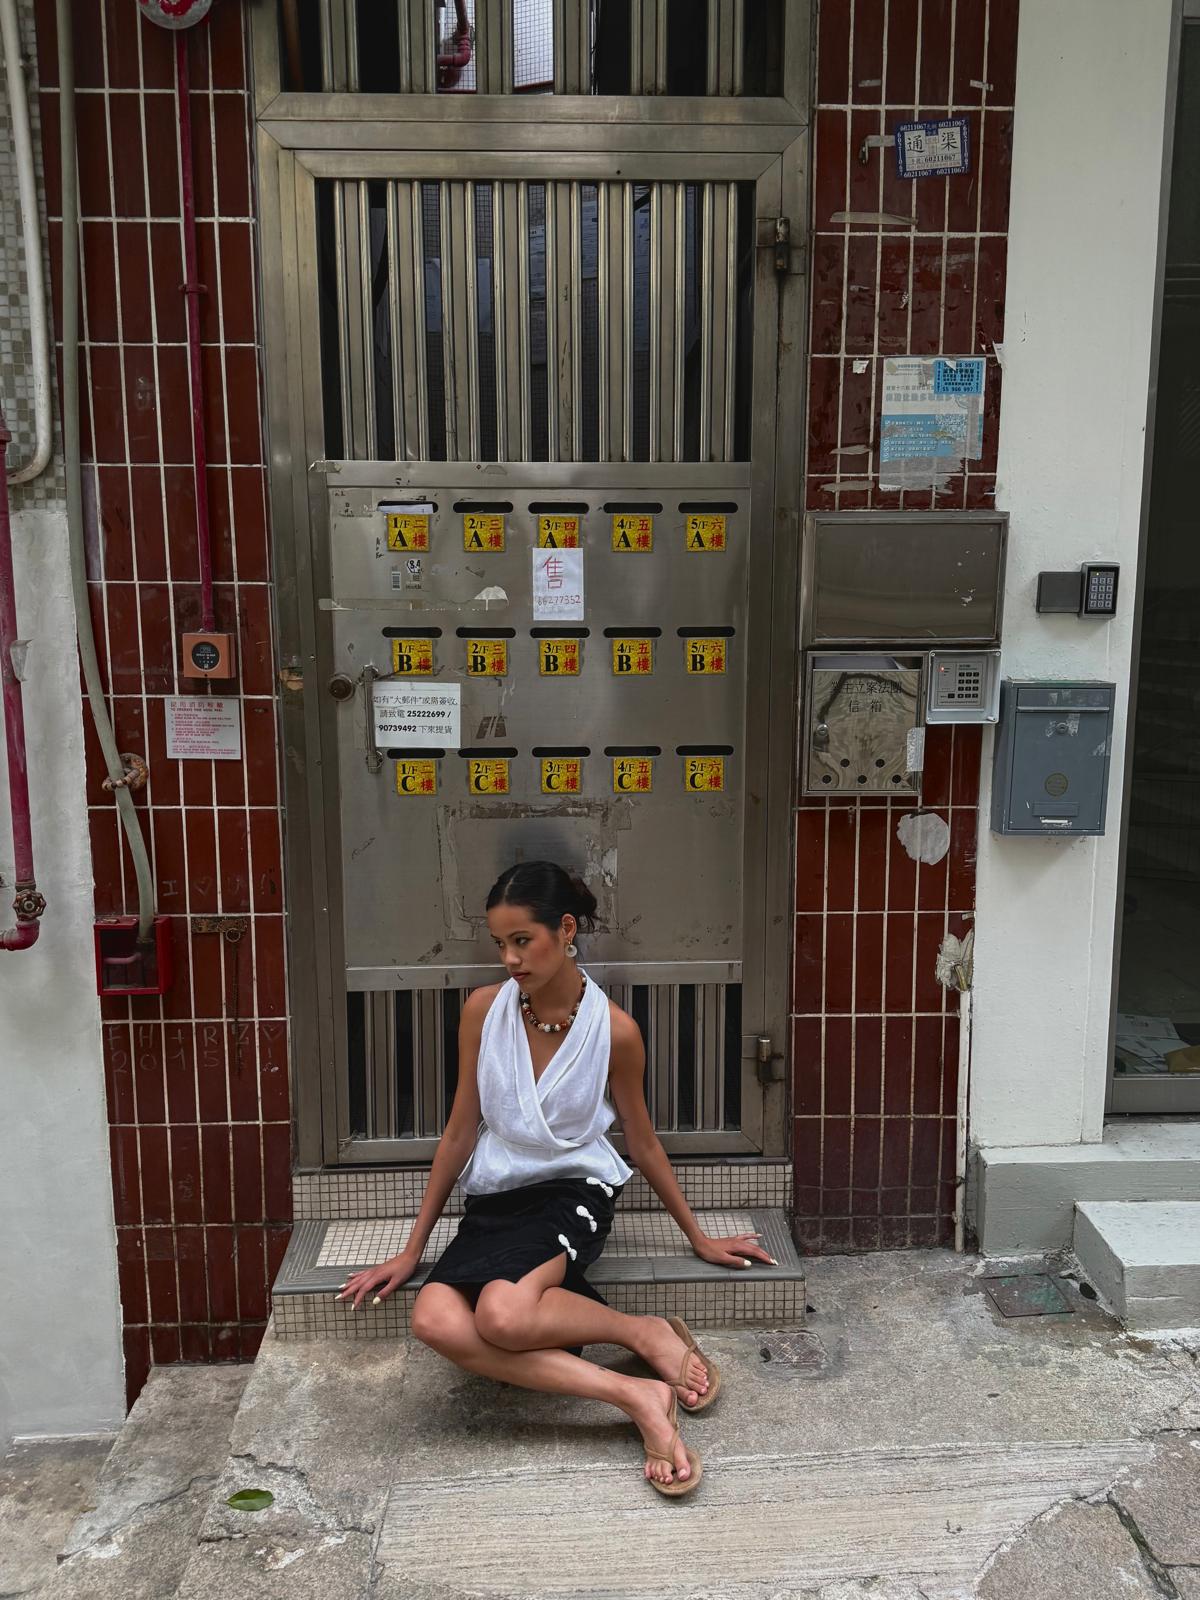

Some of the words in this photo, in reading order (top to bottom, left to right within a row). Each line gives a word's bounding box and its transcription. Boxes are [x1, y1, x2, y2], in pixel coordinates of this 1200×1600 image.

[392, 518, 410, 528] 1/F
[468, 518, 486, 530] 2/F
[544, 520, 560, 530] 3/F
[617, 519, 634, 530] 4/F
[691, 518, 708, 529] 5/F
[392, 530, 408, 547] A
[470, 530, 483, 548] A
[544, 532, 558, 548] A
[616, 530, 632, 548] A
[690, 531, 704, 548] A
[543, 556, 564, 590] 售
[398, 643, 414, 654] 1/F
[472, 644, 488, 654] 2/F
[544, 643, 560, 654] 3/F
[617, 643, 634, 654] 4/F
[692, 643, 708, 653] 5/F
[398, 654, 412, 672] B
[472, 655, 486, 672] B
[545, 655, 558, 671] B
[618, 655, 631, 671] B
[692, 654, 705, 671] B
[400, 764, 418, 774] 1/F
[474, 763, 491, 774] 2/F
[546, 762, 564, 772] 3/F
[618, 762, 634, 772] 4/F
[690, 761, 706, 772] 5/F
[402, 776, 415, 792] C
[474, 775, 489, 791] C
[546, 774, 560, 789] C
[618, 774, 632, 789] C
[690, 773, 704, 789] C
